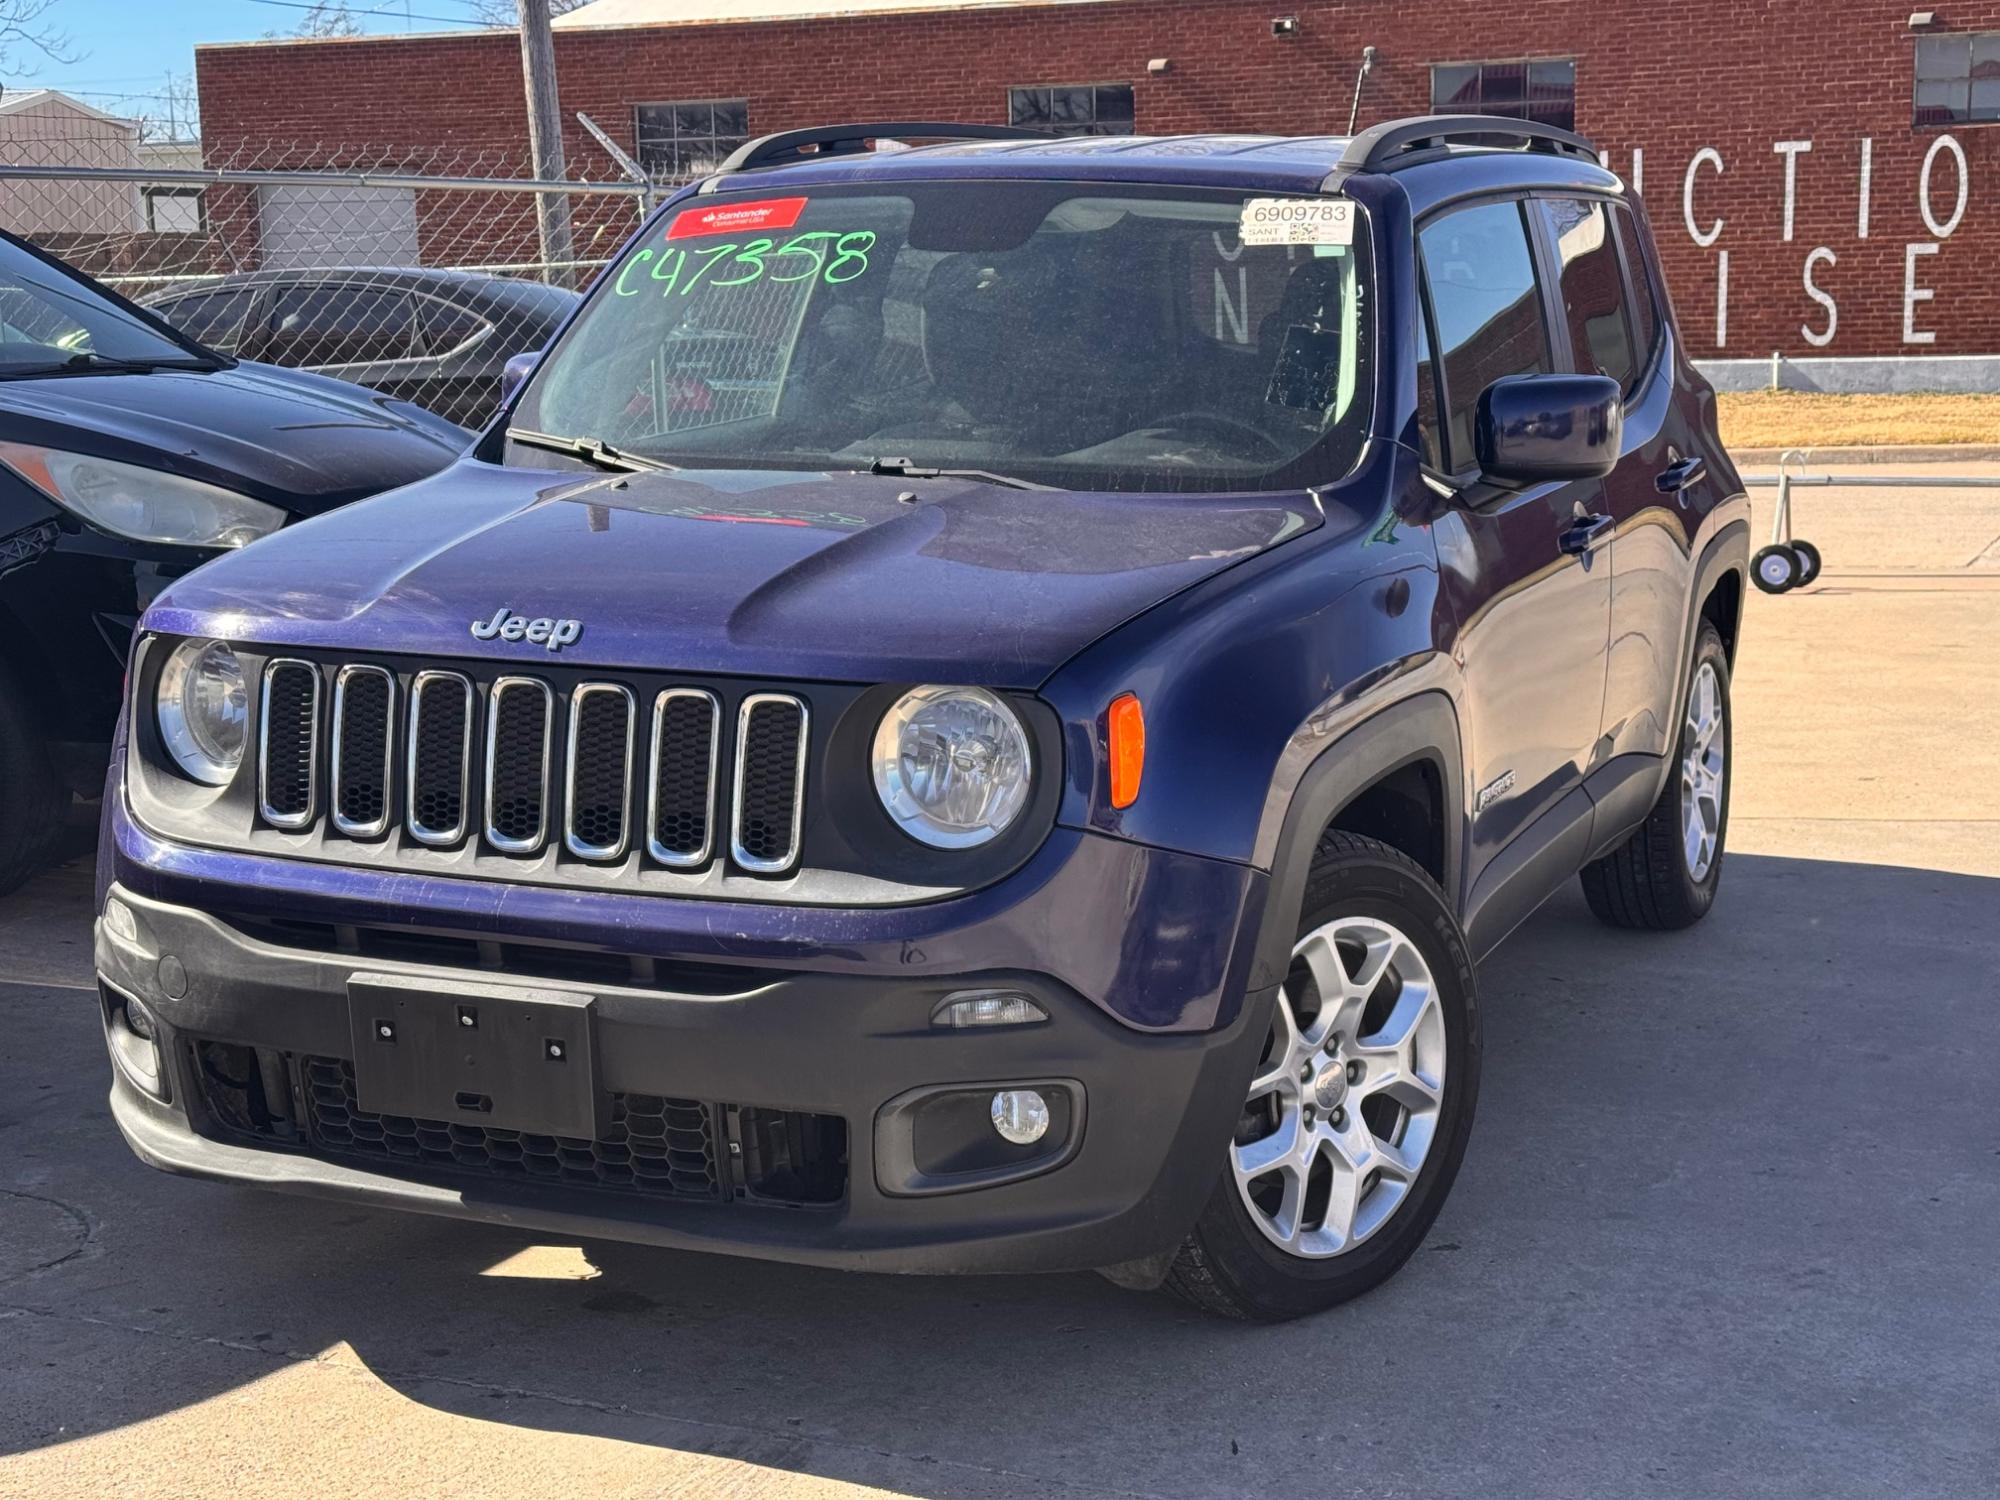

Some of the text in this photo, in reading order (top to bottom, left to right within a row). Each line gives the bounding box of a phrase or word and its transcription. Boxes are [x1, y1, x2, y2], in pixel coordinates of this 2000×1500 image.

[717, 207, 774, 221] Santander
[1254, 206, 1346, 222] 6909783
[1248, 227, 1280, 236] SANT
[615, 231, 876, 297] C47358
[471, 608, 583, 653] Jeep
